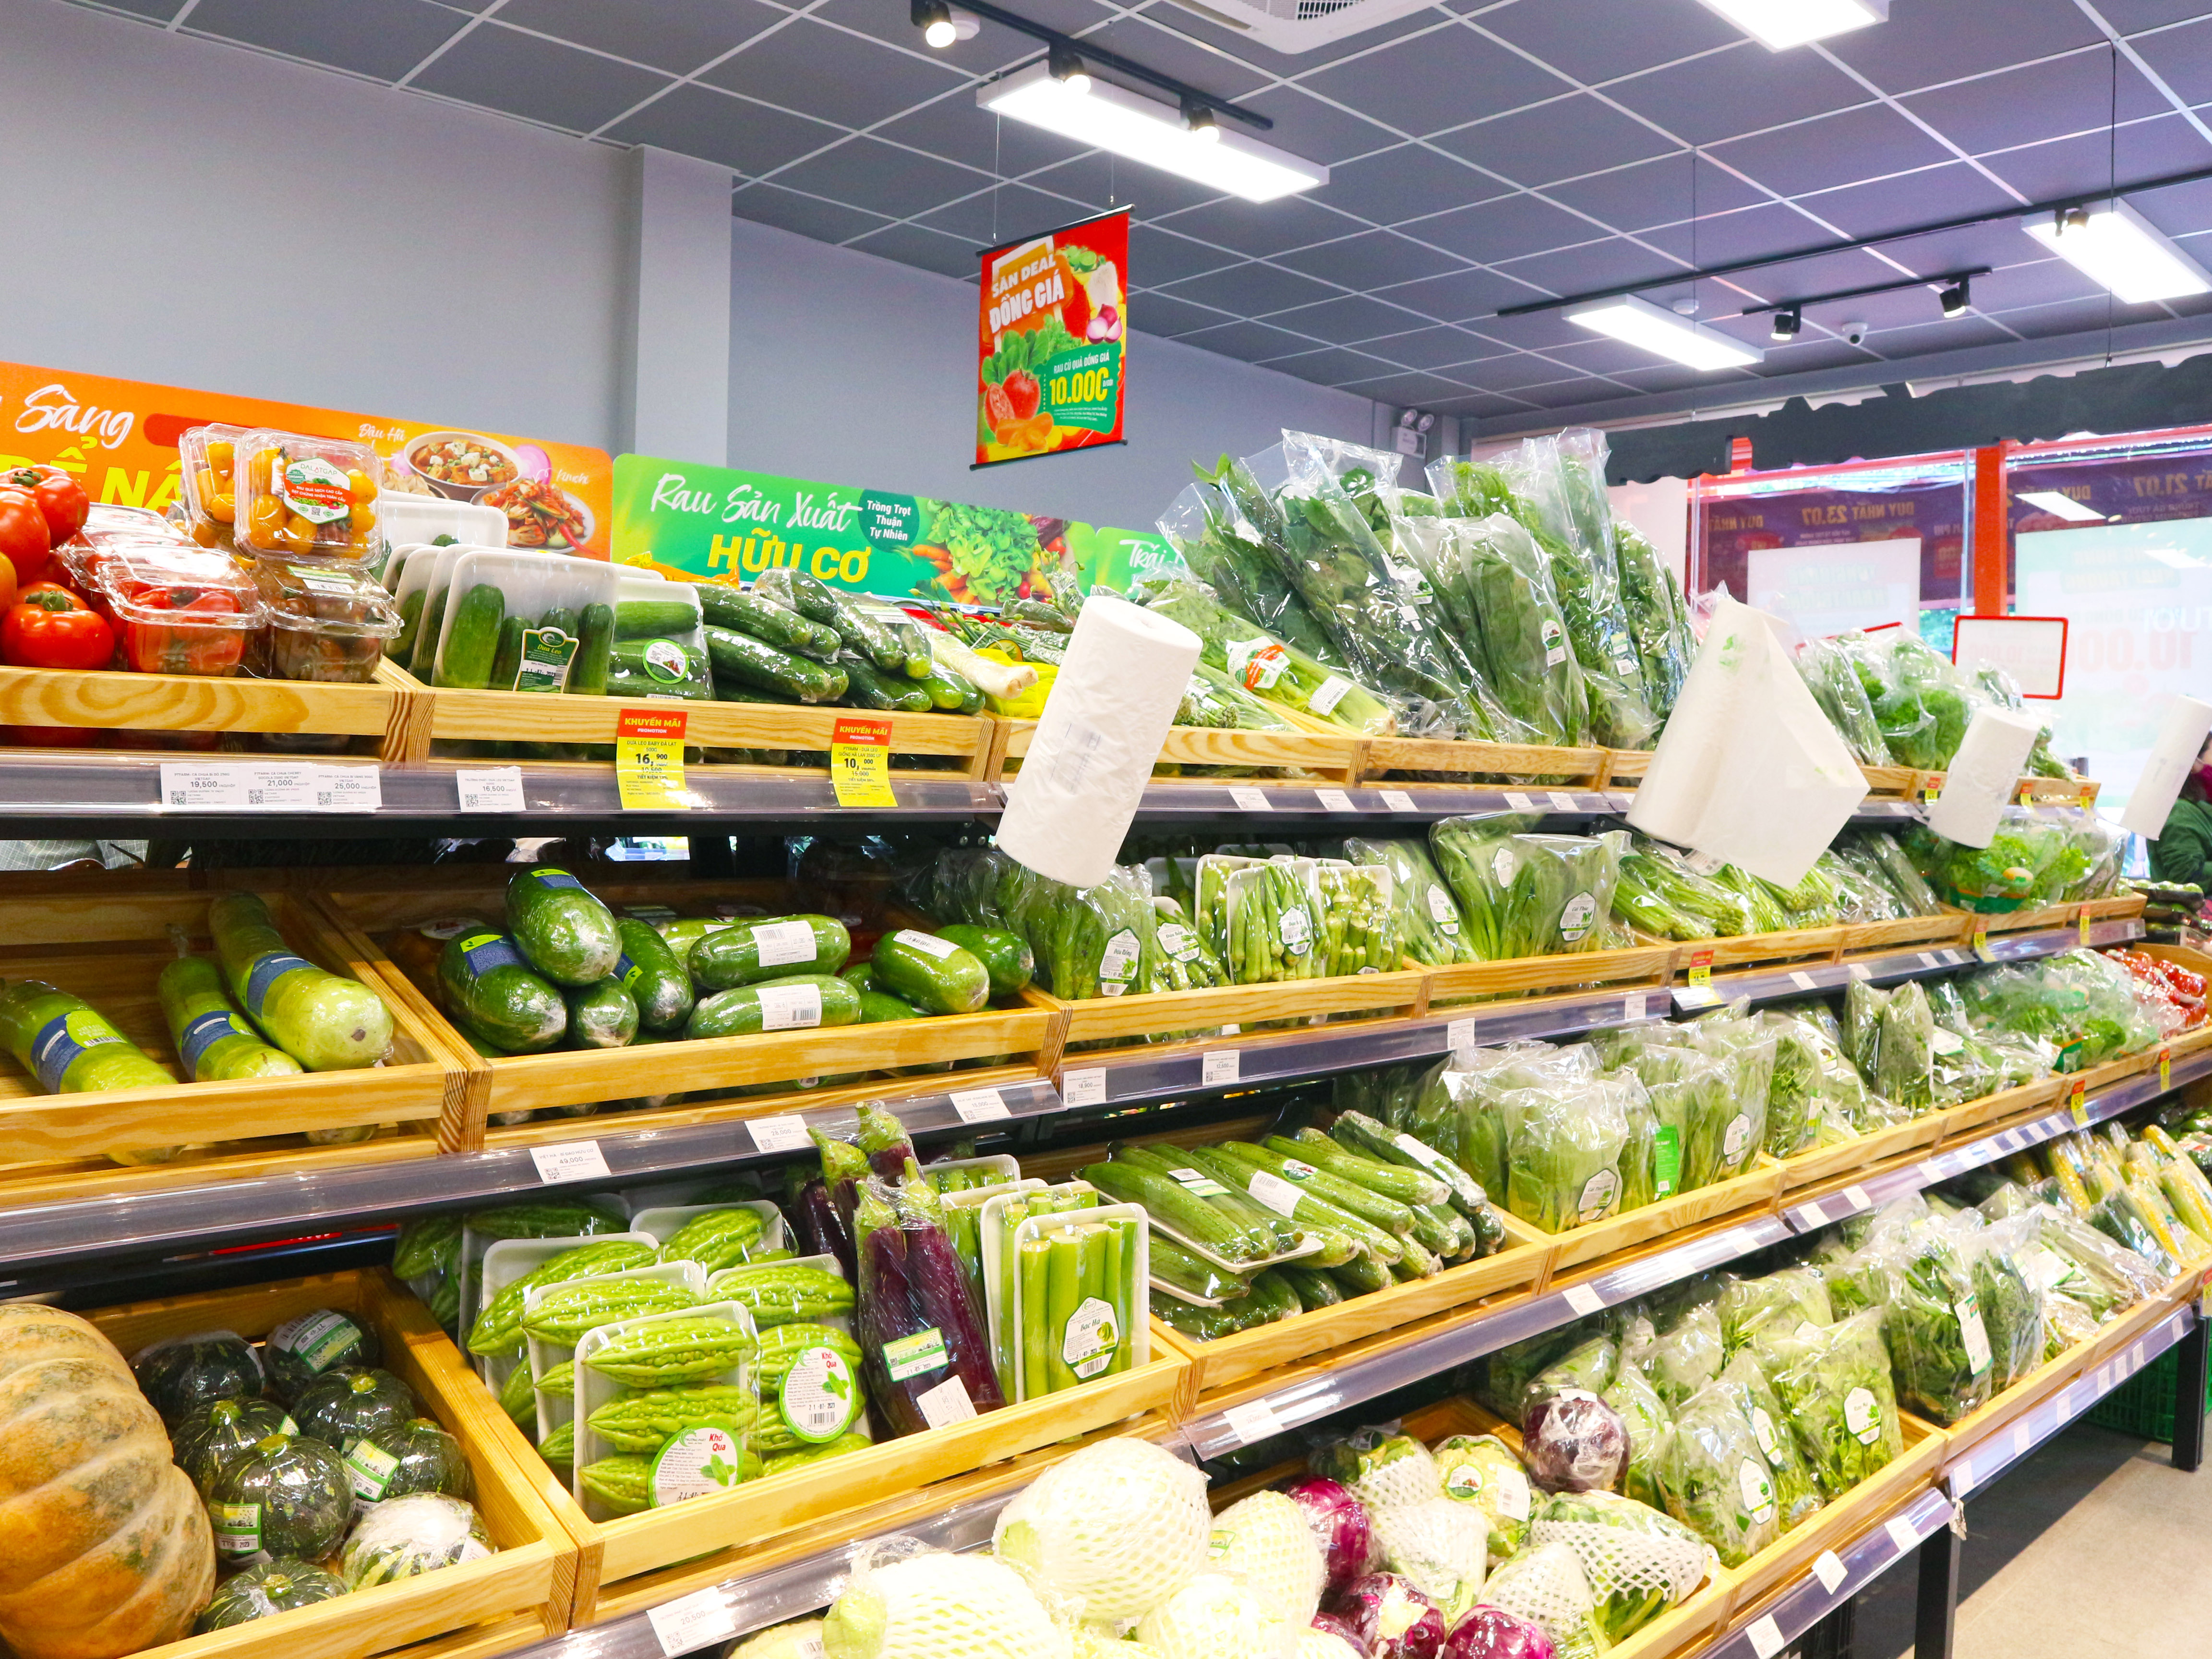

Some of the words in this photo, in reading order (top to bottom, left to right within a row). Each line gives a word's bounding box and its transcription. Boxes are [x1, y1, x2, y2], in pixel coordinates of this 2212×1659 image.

[1021, 254, 1056, 281] DEAL
[989, 289, 1033, 334] ĐỒNG
[1034, 268, 1065, 308] GIÁ
[1054, 363, 1063, 374] RAU
[1072, 355, 1083, 370] QUẢ
[1099, 349, 1110, 363] GIÁ
[15, 384, 134, 449] Sàng
[359, 423, 384, 439] Đậu
[387, 426, 405, 442] Hũ
[650, 473, 717, 514] Rau
[722, 484, 781, 524] Sản
[786, 492, 863, 532] Xuất
[867, 500, 892, 516] Trồng
[893, 504, 912, 518] Trọt
[875, 514, 903, 529] Thuận
[869, 526, 882, 539] Tự
[882, 527, 908, 541] Nhiên
[707, 527, 803, 573] HỮU
[810, 546, 872, 584] CƠ
[625, 717, 662, 727] KHUYẾN
[663, 718, 681, 727] MÃI
[840, 725, 871, 734] KHUYẾN
[335, 782, 360, 791] 25,000
[771, 1129, 792, 1137] 28,000
[559, 1156, 584, 1166] 49,000
[1080, 1322, 1091, 1332] Bạc
[1091, 1317, 1101, 1327] Hà
[821, 1349, 832, 1360] Khổ
[826, 1360, 837, 1369] Qua
[709, 1432, 724, 1443] Khổ
[712, 1443, 726, 1452] Qua
[681, 1610, 706, 1625] 20,500
